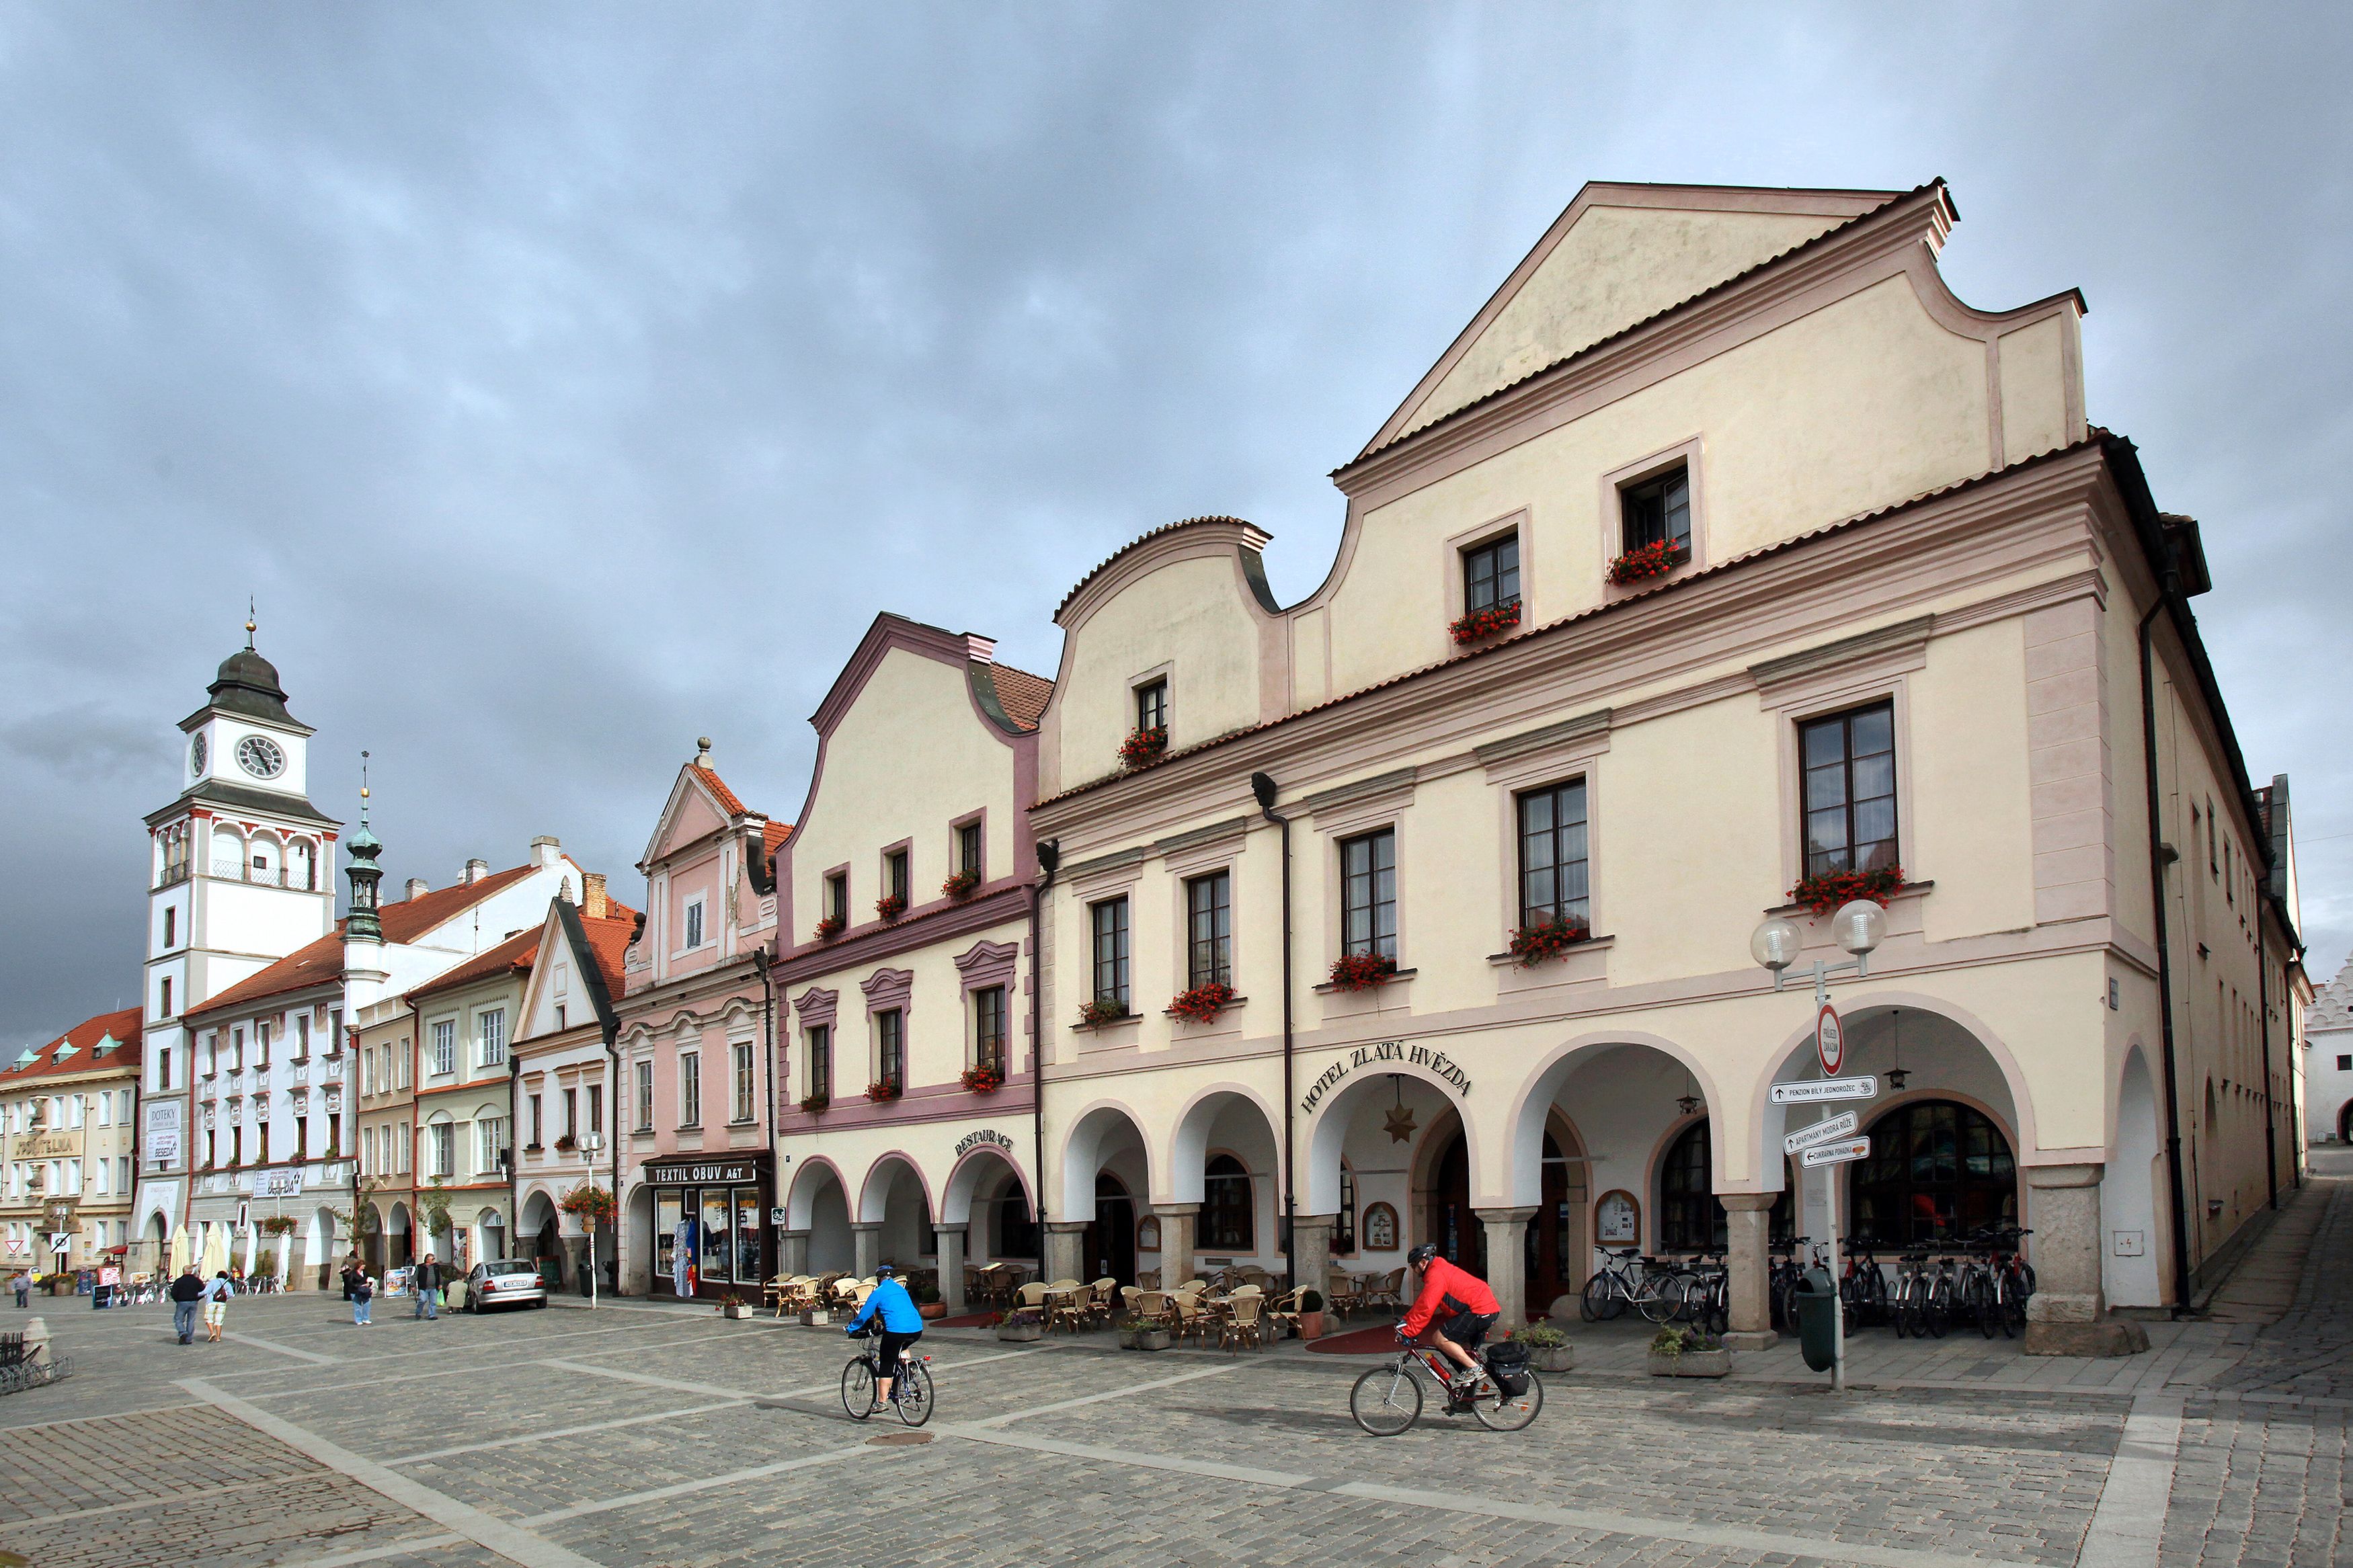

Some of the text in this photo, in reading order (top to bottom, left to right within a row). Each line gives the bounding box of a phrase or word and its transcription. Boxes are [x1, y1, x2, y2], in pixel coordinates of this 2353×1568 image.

[1300, 1040, 1472, 1115] HOTEL ZLATÁ HVĚZDA
[1789, 1084, 1856, 1096] PENZION BÍLÝ JEDNOROŽEC
[151, 1108, 175, 1121] DOTEKY
[1796, 1118, 1852, 1145] APARTMÁNY MODRÁ RŮŽE
[955, 1129, 1013, 1157] RESTAURACE
[155, 1147, 173, 1157] BESEDA
[655, 1166, 743, 1182] TEXTIL OBUV A&T
